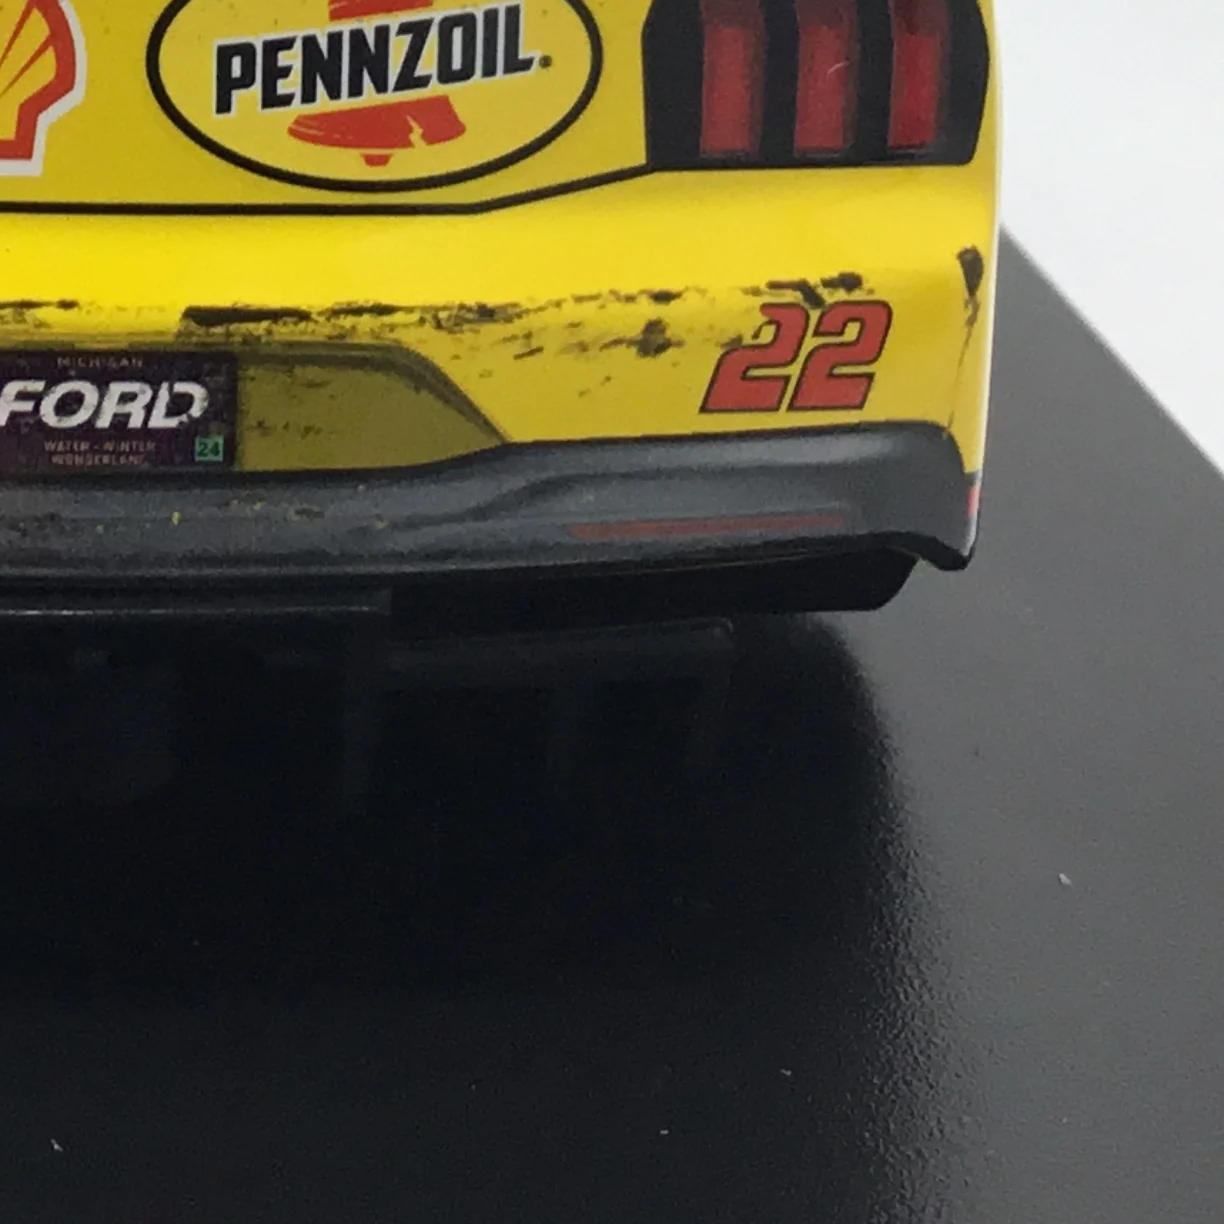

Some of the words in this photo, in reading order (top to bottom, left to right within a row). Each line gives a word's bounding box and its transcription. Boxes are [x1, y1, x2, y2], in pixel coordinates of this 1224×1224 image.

[214, 2, 536, 116] PENNZOIL
[699, 299, 893, 414] 22
[196, 441, 221, 458] 24
